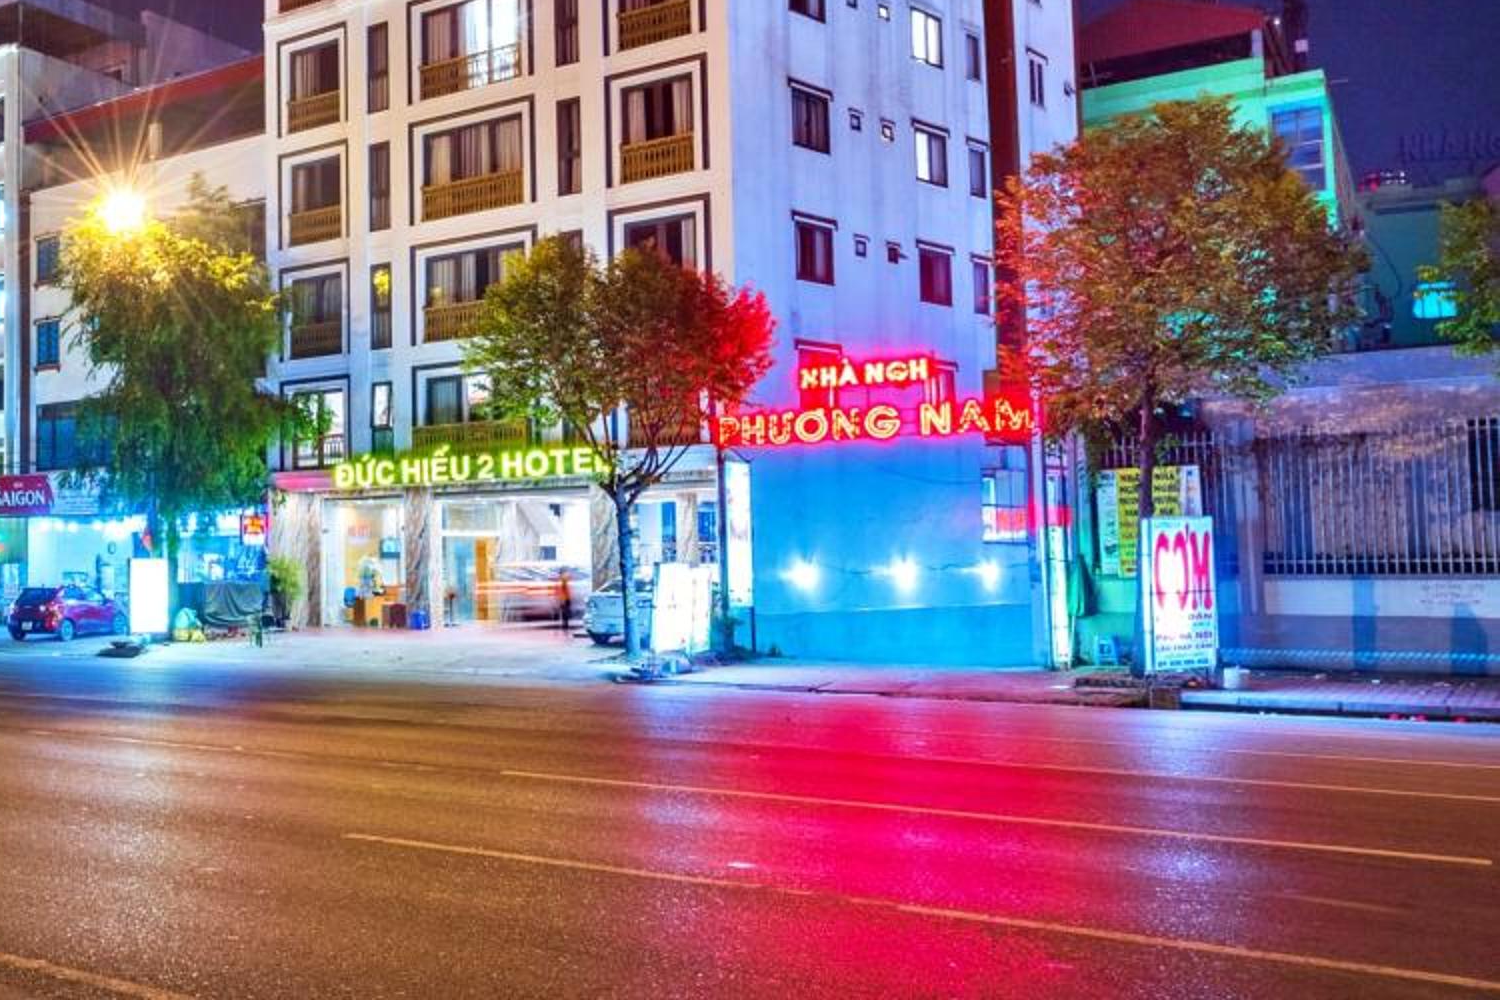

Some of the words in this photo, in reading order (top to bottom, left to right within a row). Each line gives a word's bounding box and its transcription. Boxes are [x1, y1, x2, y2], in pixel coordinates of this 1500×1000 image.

[800, 358, 857, 389] NHÀ
[718, 404, 901, 447] PHƯƠNG
[334, 453, 395, 488] ĐỨC
[401, 444, 470, 485] HIẾU
[477, 454, 495, 479] 2
